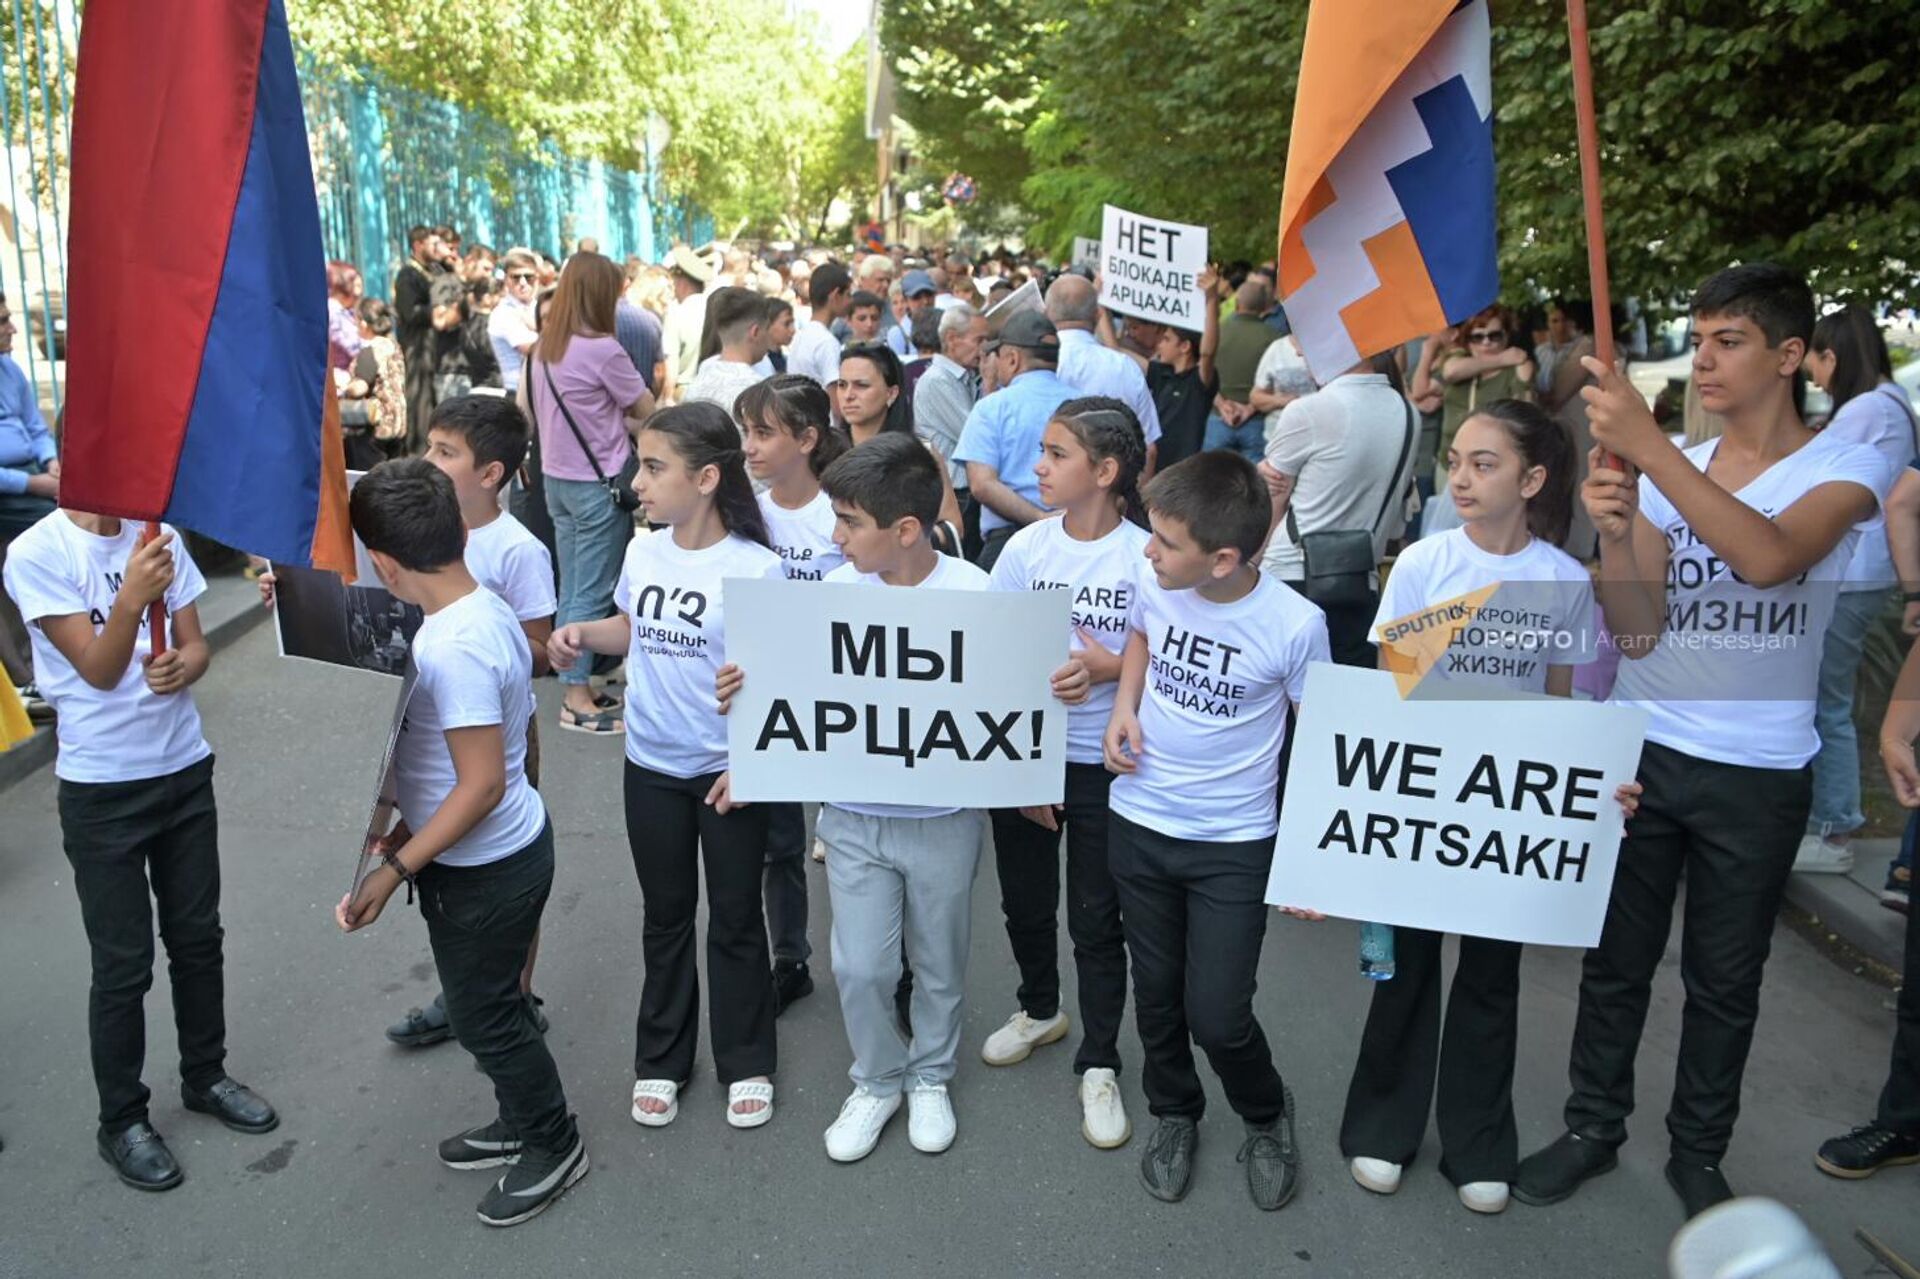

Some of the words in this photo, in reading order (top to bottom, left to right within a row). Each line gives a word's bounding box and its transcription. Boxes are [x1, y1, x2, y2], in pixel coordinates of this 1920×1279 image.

[1118, 216, 1181, 262] НЕТ
[1108, 256, 1193, 293] БЛОКАДЕ
[1110, 283, 1190, 318] АРЦАХА!
[1074, 586, 1128, 610] ARE
[637, 624, 707, 649] ԱՐՑԱԽԻ
[1071, 611, 1127, 633] SAKH
[831, 621, 964, 683] МЫ
[1161, 625, 1241, 676] НЕТ
[1447, 654, 1538, 678] ЖИЗНИ!
[1151, 655, 1246, 700] БЛОКАДЕ
[1154, 679, 1238, 718] АРЦАХА!
[755, 698, 1044, 768] АРЦАХ!
[1335, 733, 1443, 799] WE
[1455, 753, 1604, 821] ARE
[1317, 809, 1591, 883] ARTSAKH
